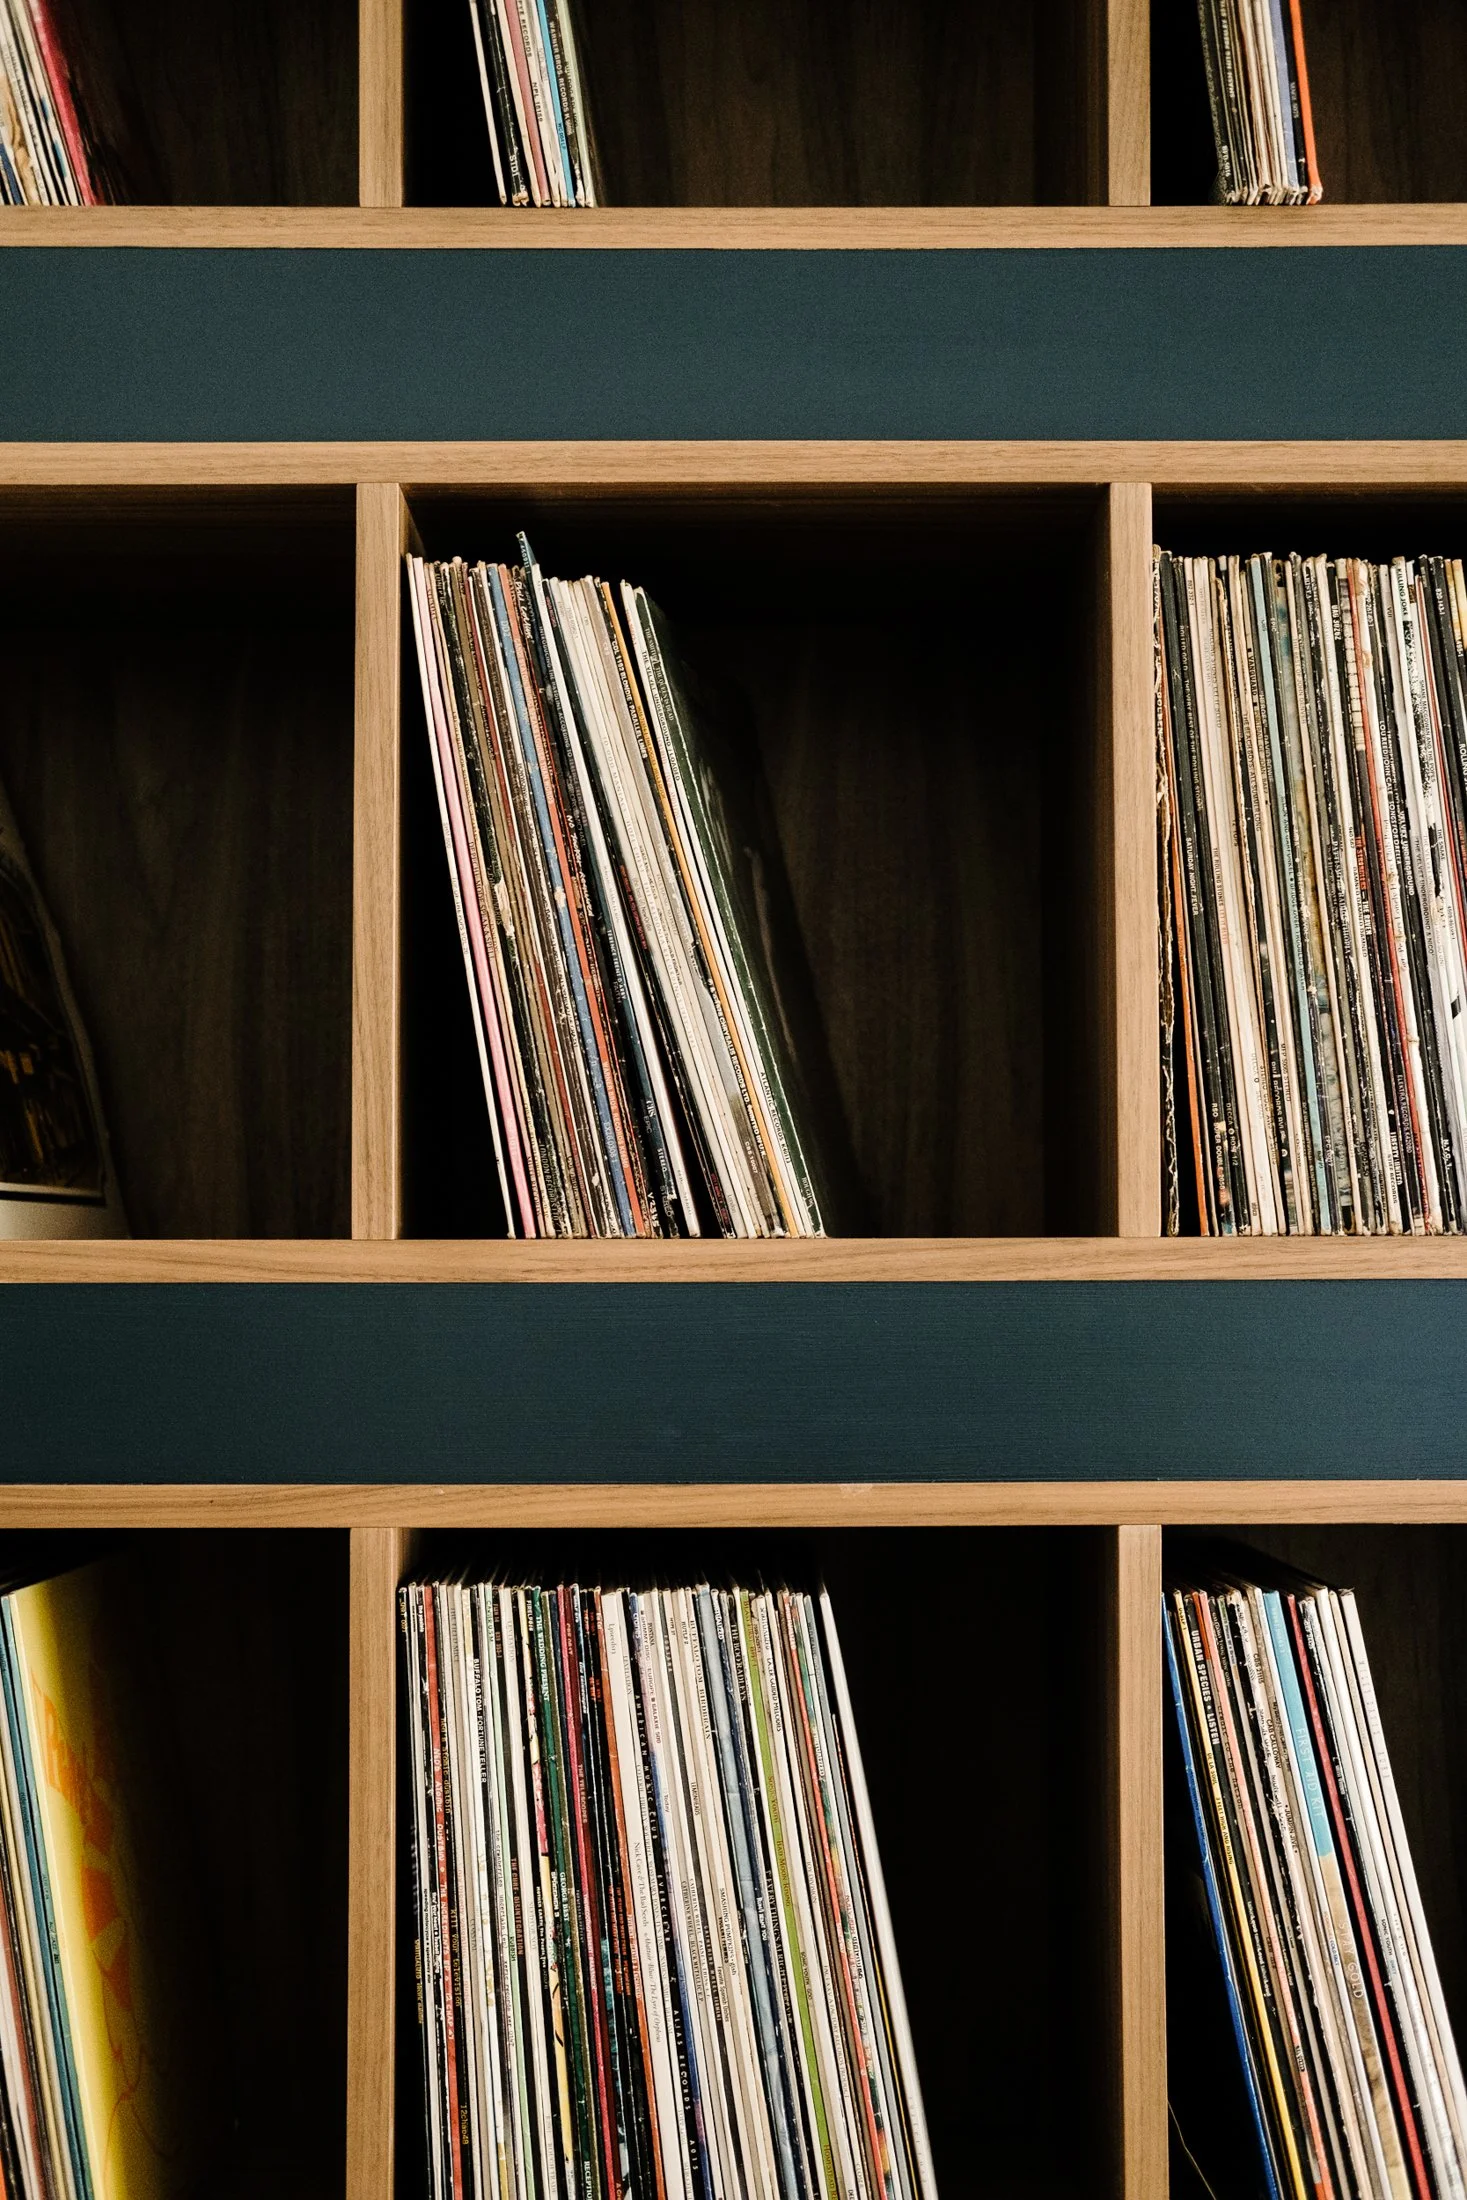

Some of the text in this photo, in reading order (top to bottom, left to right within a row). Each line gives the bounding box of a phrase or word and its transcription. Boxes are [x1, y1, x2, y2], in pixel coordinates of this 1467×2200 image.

[1396, 568, 1405, 596] KILLING
[1248, 655, 1256, 695] VANGUARD
[619, 671, 632, 701] BLONDIE
[628, 704, 642, 738] PARALLEL
[539, 761, 548, 779] THAN
[1185, 837, 1199, 915] SATURDAY NIGHT FEVER
[1213, 859, 1221, 883] ROLLING
[1403, 840, 1415, 896] UNDERGROUND
[600, 1061, 612, 1090] WARNER
[612, 1112, 625, 1144] RECORDS
[537, 1632, 545, 1667] WEDDING
[539, 1669, 548, 1701] PRESENT
[1190, 1629, 1220, 1746] URBAN SPECIES LISTEN
[476, 1715, 484, 1751] FORTUNE
[1269, 1733, 1281, 1769] CALLOWAY
[578, 1778, 587, 1823] TELESCOPES
[1310, 1796, 1323, 1818] KIT
[559, 1871, 567, 1902] GEORGE
[440, 1901, 450, 1954] INGREDIENTS
